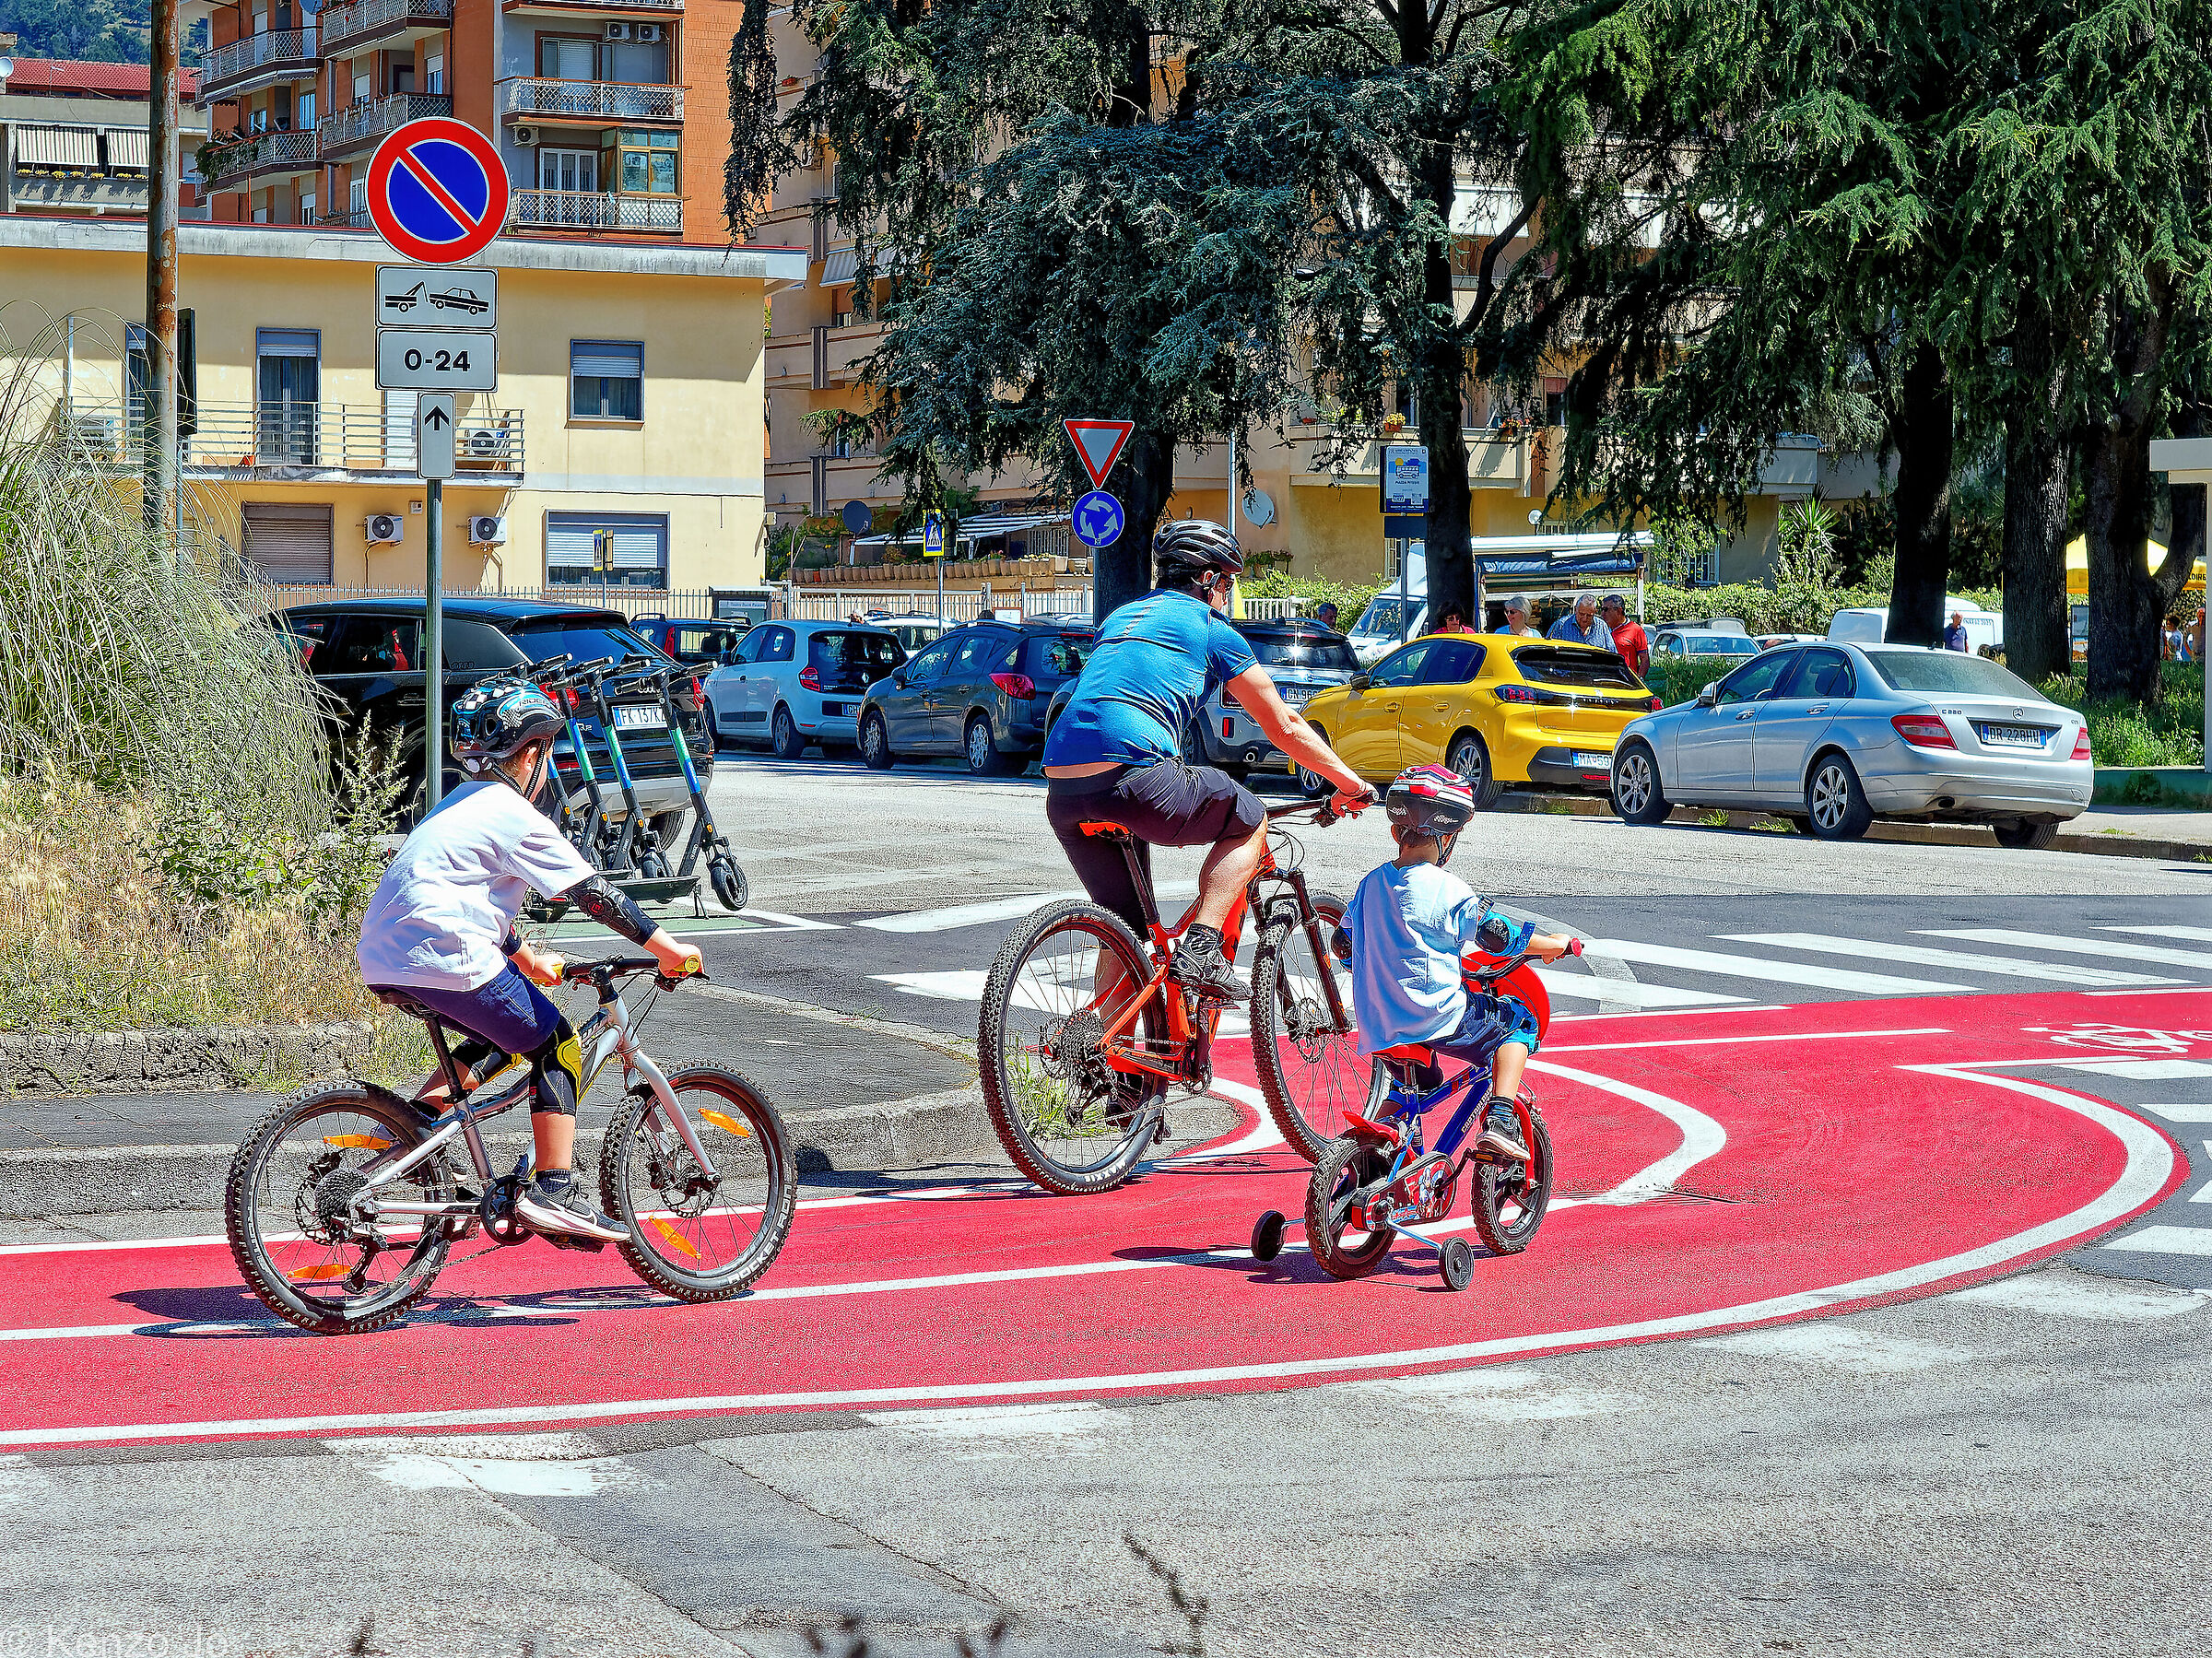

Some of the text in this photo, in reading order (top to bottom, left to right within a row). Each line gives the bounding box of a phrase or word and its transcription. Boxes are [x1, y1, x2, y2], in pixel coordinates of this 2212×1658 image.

[404, 348, 471, 371] 0-24
[620, 708, 635, 724] FK
[1989, 727, 2003, 741] DR
[726, 1183, 793, 1285] ROCKET RON
